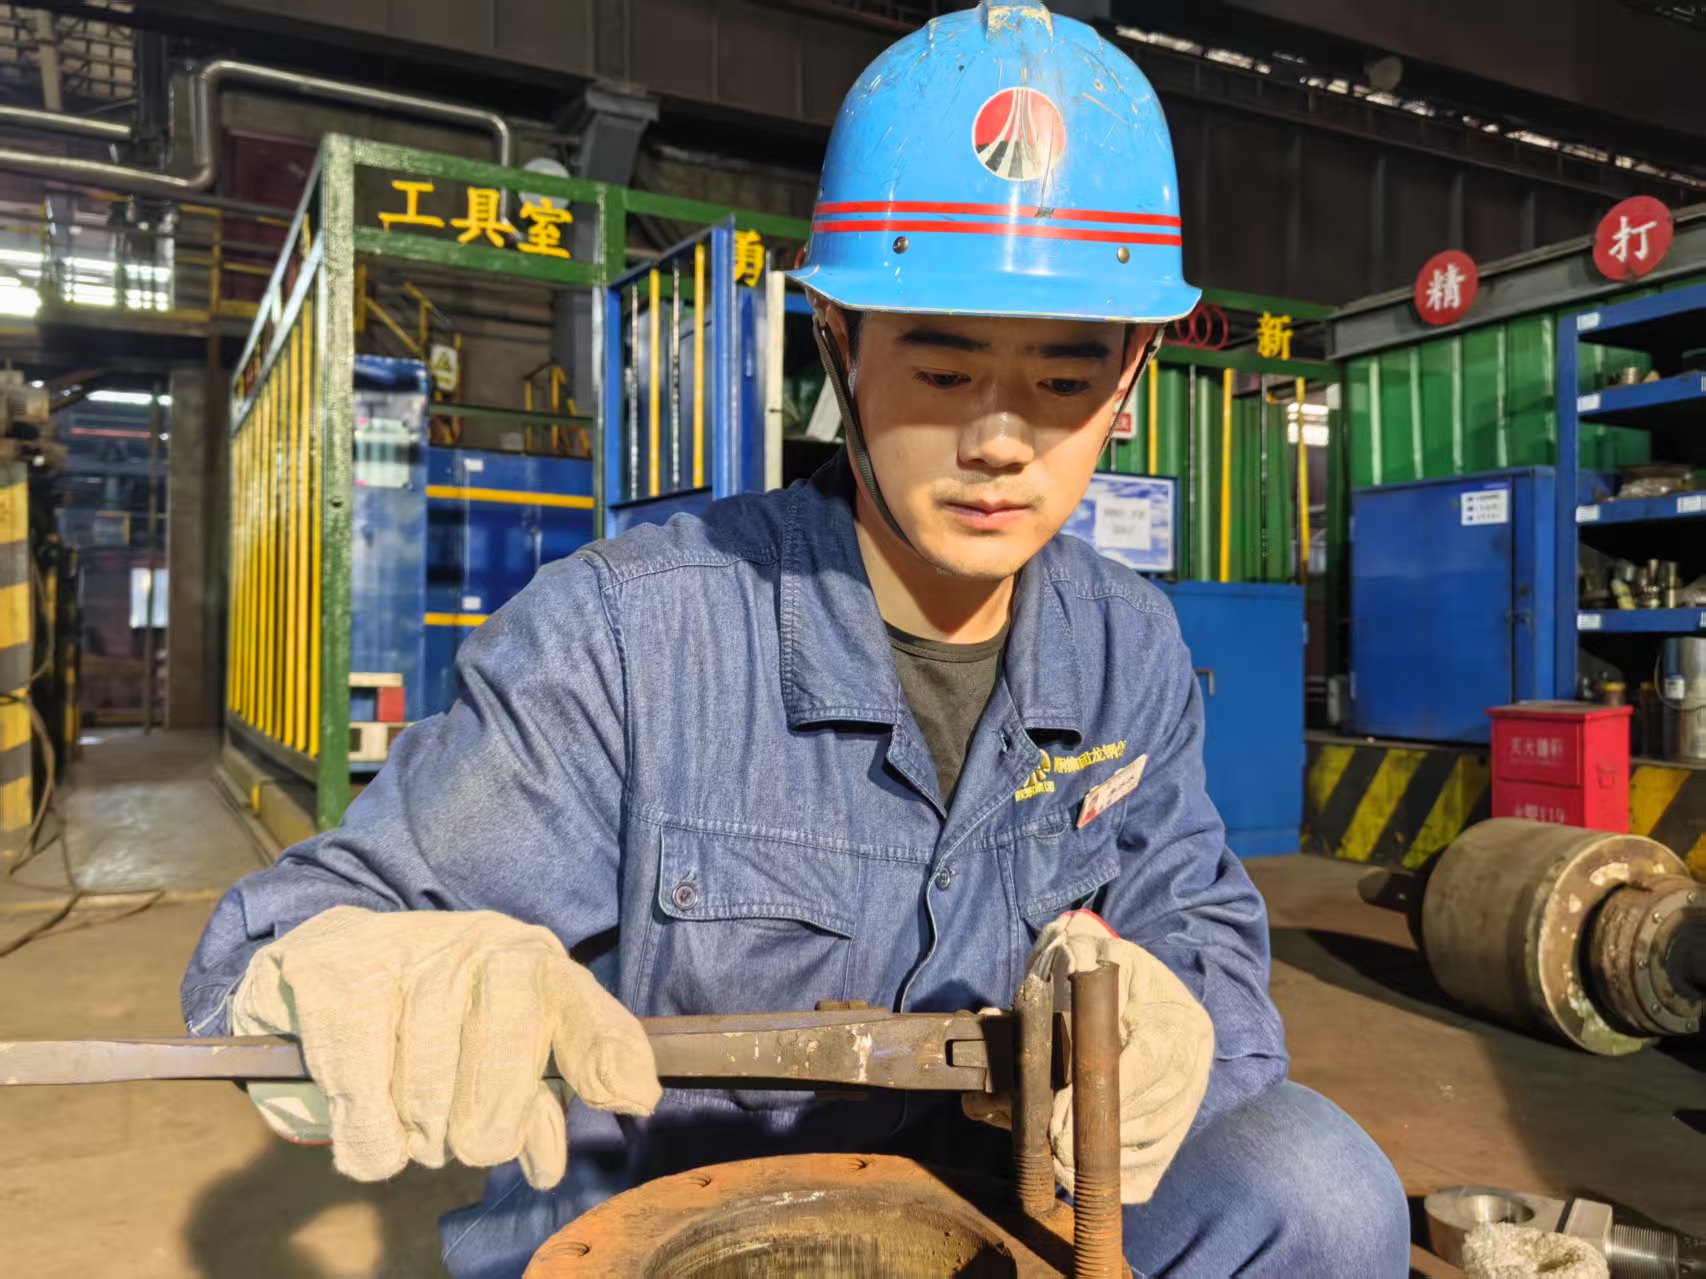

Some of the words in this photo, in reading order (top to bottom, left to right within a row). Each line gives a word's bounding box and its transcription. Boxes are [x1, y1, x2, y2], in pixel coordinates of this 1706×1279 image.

[378, 180, 574, 259] 工具室
[1426, 263, 1465, 312] 精
[1608, 215, 1658, 263] 打
[1257, 311, 1294, 361] 新
